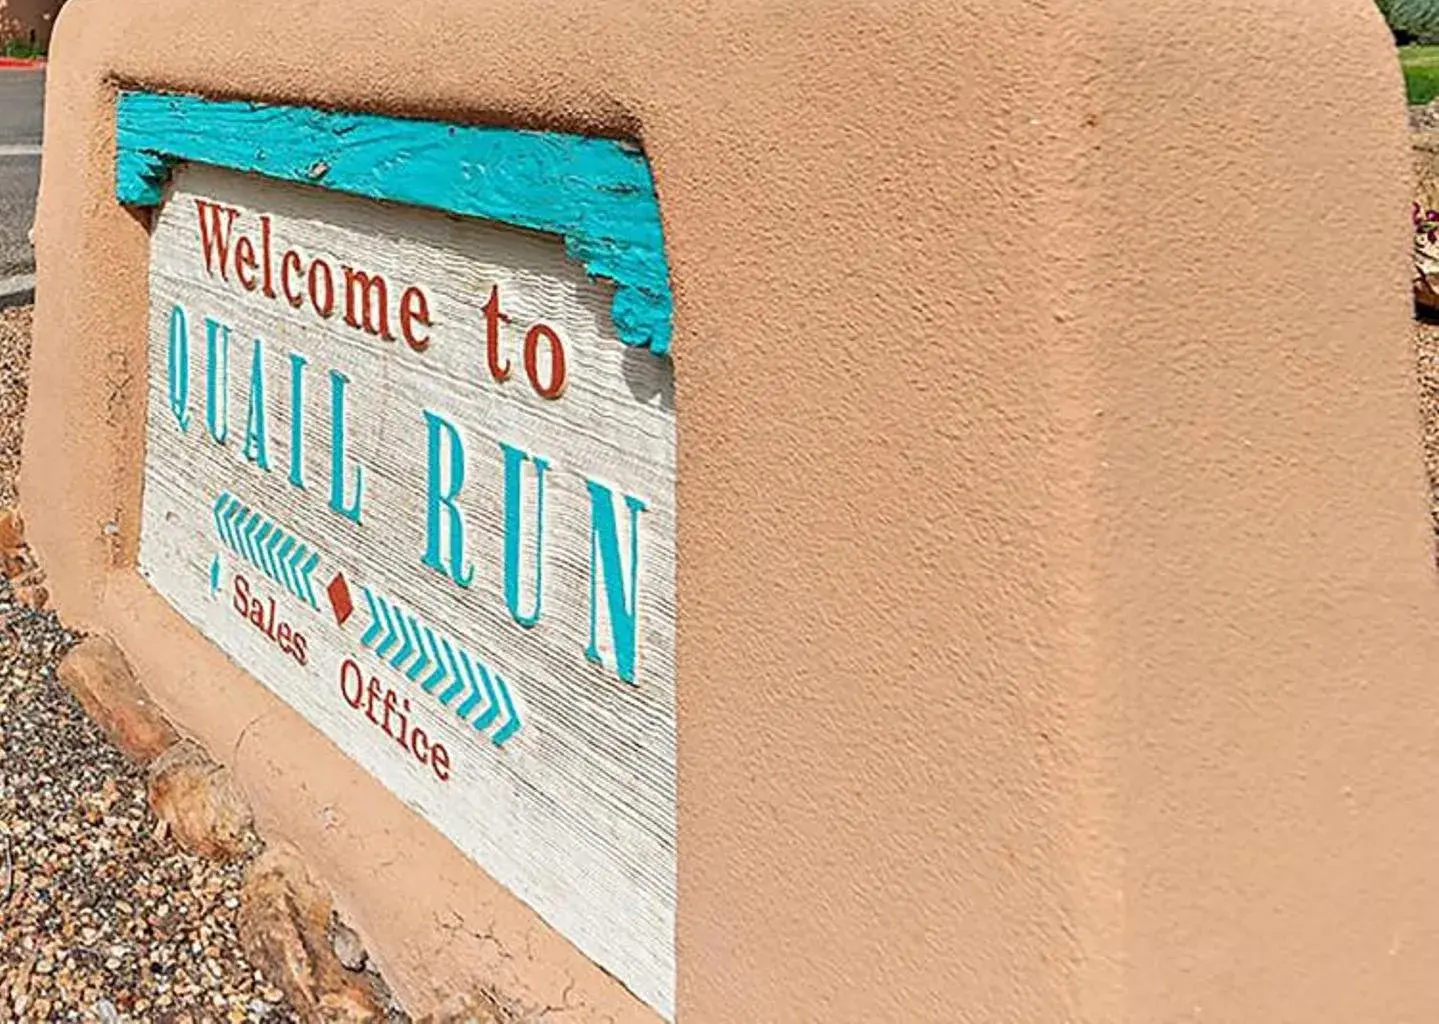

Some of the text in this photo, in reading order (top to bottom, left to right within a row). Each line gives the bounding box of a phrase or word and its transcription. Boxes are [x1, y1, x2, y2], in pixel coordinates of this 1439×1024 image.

[194, 199, 568, 400] Welcome to
[167, 304, 649, 686] QUAIL RUN
[233, 575, 450, 781] Sales Office
